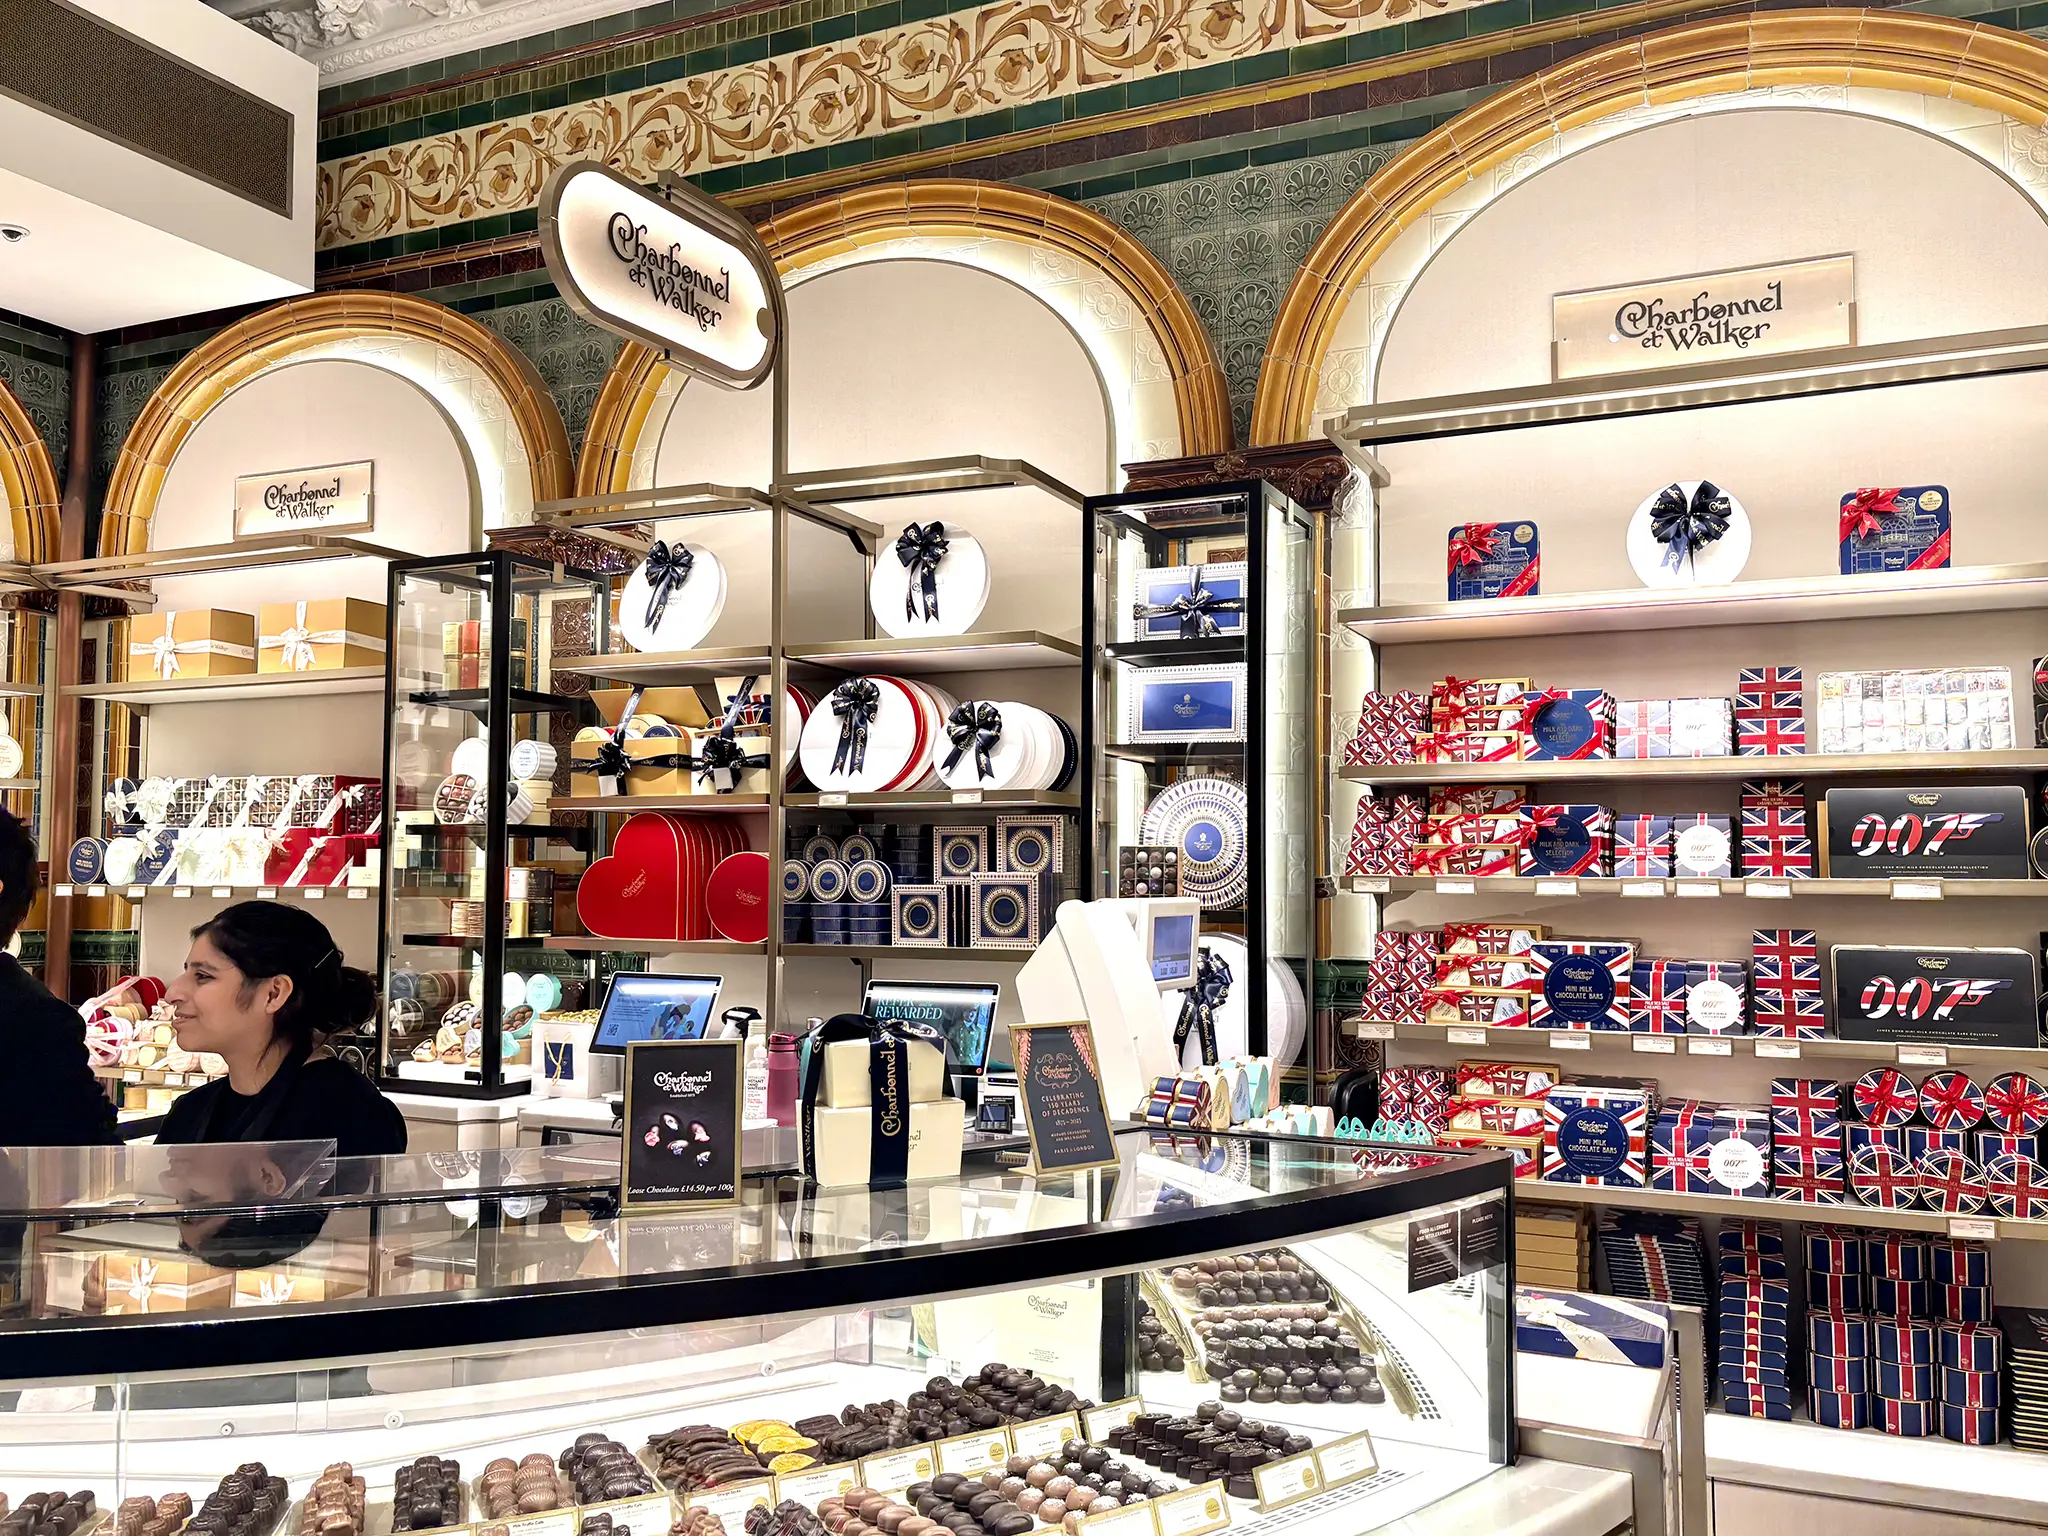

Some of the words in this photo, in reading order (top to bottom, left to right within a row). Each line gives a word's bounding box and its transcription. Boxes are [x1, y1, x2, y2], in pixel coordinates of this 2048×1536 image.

[608, 212, 730, 303] Charbonnel
[629, 267, 647, 288] et
[649, 268, 722, 332] Walker
[1615, 281, 1783, 339] Charbonnel
[1642, 330, 1664, 348] et
[1664, 318, 1771, 351] Walker
[264, 477, 340, 510] Charbonnel
[276, 508, 287, 518] et
[287, 501, 335, 521] Walker
[1851, 812, 2004, 857] 007
[1860, 975, 2014, 1020] 007
[875, 1005, 942, 1020] REWARDED
[1042, 1063, 1073, 1076] Charbonnel
[653, 1070, 711, 1087] Charbonnel
[671, 1081, 708, 1095] Walker
[881, 1049, 901, 1137] Charbonnel
[1041, 1091, 1085, 1103] CELEBRATING
[1052, 1105, 1090, 1116] DECADENCE
[1568, 1144, 1600, 1152] CHOCOLATE
[1602, 1146, 1617, 1154] BARS
[1724, 1159, 1741, 1167] 007
[627, 1186, 645, 1194] Loose
[646, 1185, 680, 1194] Chocolates
[680, 1184, 705, 1192] £14.50
[705, 1185, 717, 1193] per
[717, 1183, 734, 1193] 100g
[1425, 1229, 1452, 1239] INTOLERANCES
[1028, 1295, 1068, 1310] Charbonnel
[1039, 1305, 1065, 1318] Walker
